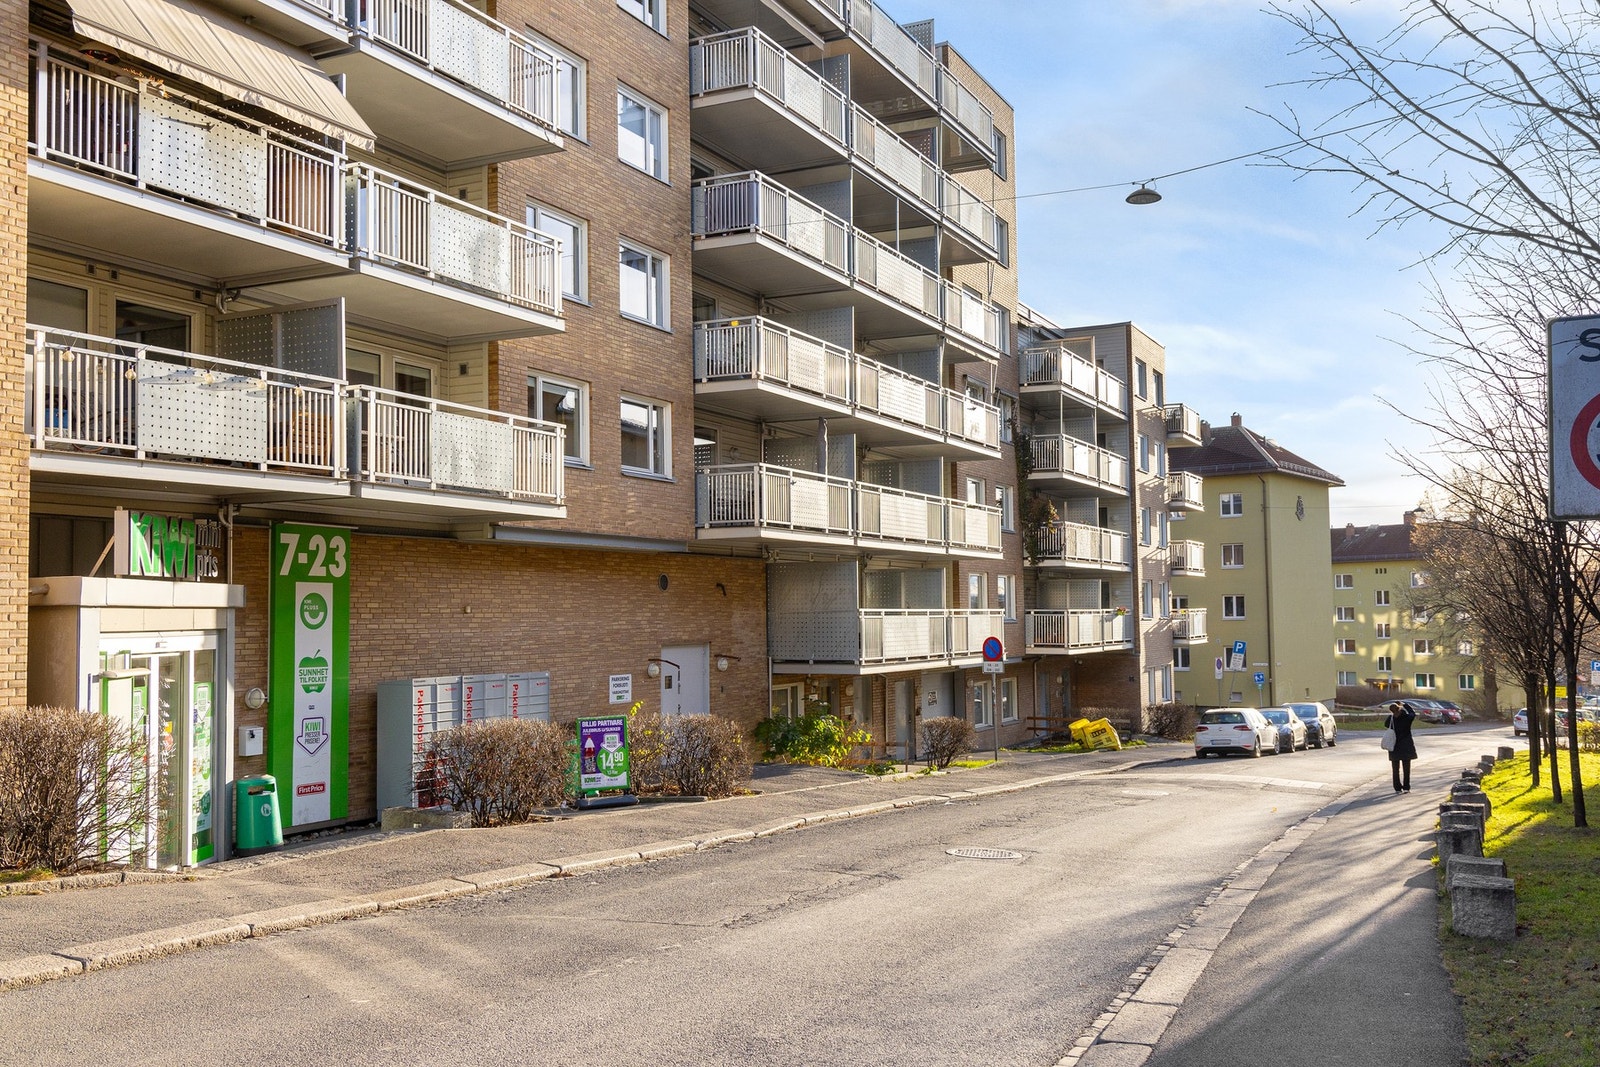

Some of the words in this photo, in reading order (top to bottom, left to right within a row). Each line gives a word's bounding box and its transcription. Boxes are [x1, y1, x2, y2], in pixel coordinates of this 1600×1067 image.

[130, 511, 195, 578] KIWI
[280, 533, 346, 577] 7-23
[197, 550, 218, 581] pris
[1235, 642, 1243, 652] P
[299, 668, 328, 676] SUNNHET
[305, 722, 320, 731] KIWI
